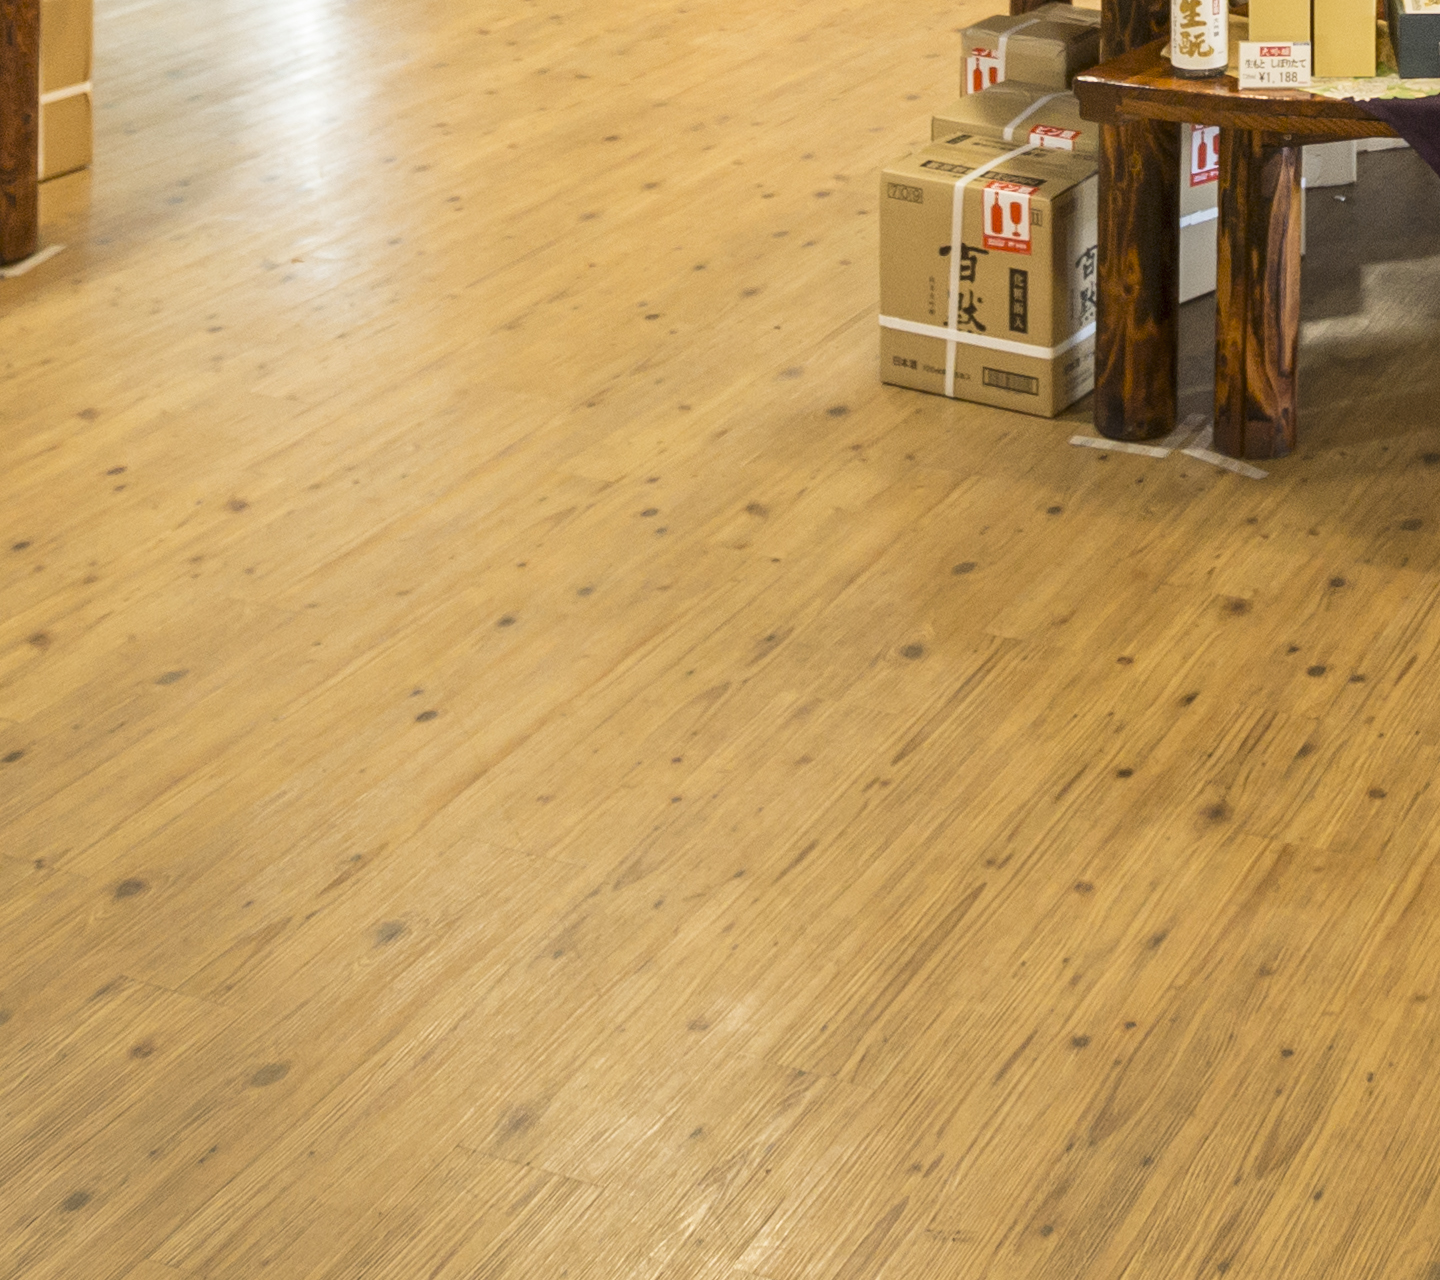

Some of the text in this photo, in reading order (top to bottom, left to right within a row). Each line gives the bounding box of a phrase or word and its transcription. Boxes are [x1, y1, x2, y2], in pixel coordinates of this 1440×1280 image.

[1271, 59, 1306, 69] しぼりたて
[893, 356, 918, 370] 日本酒
